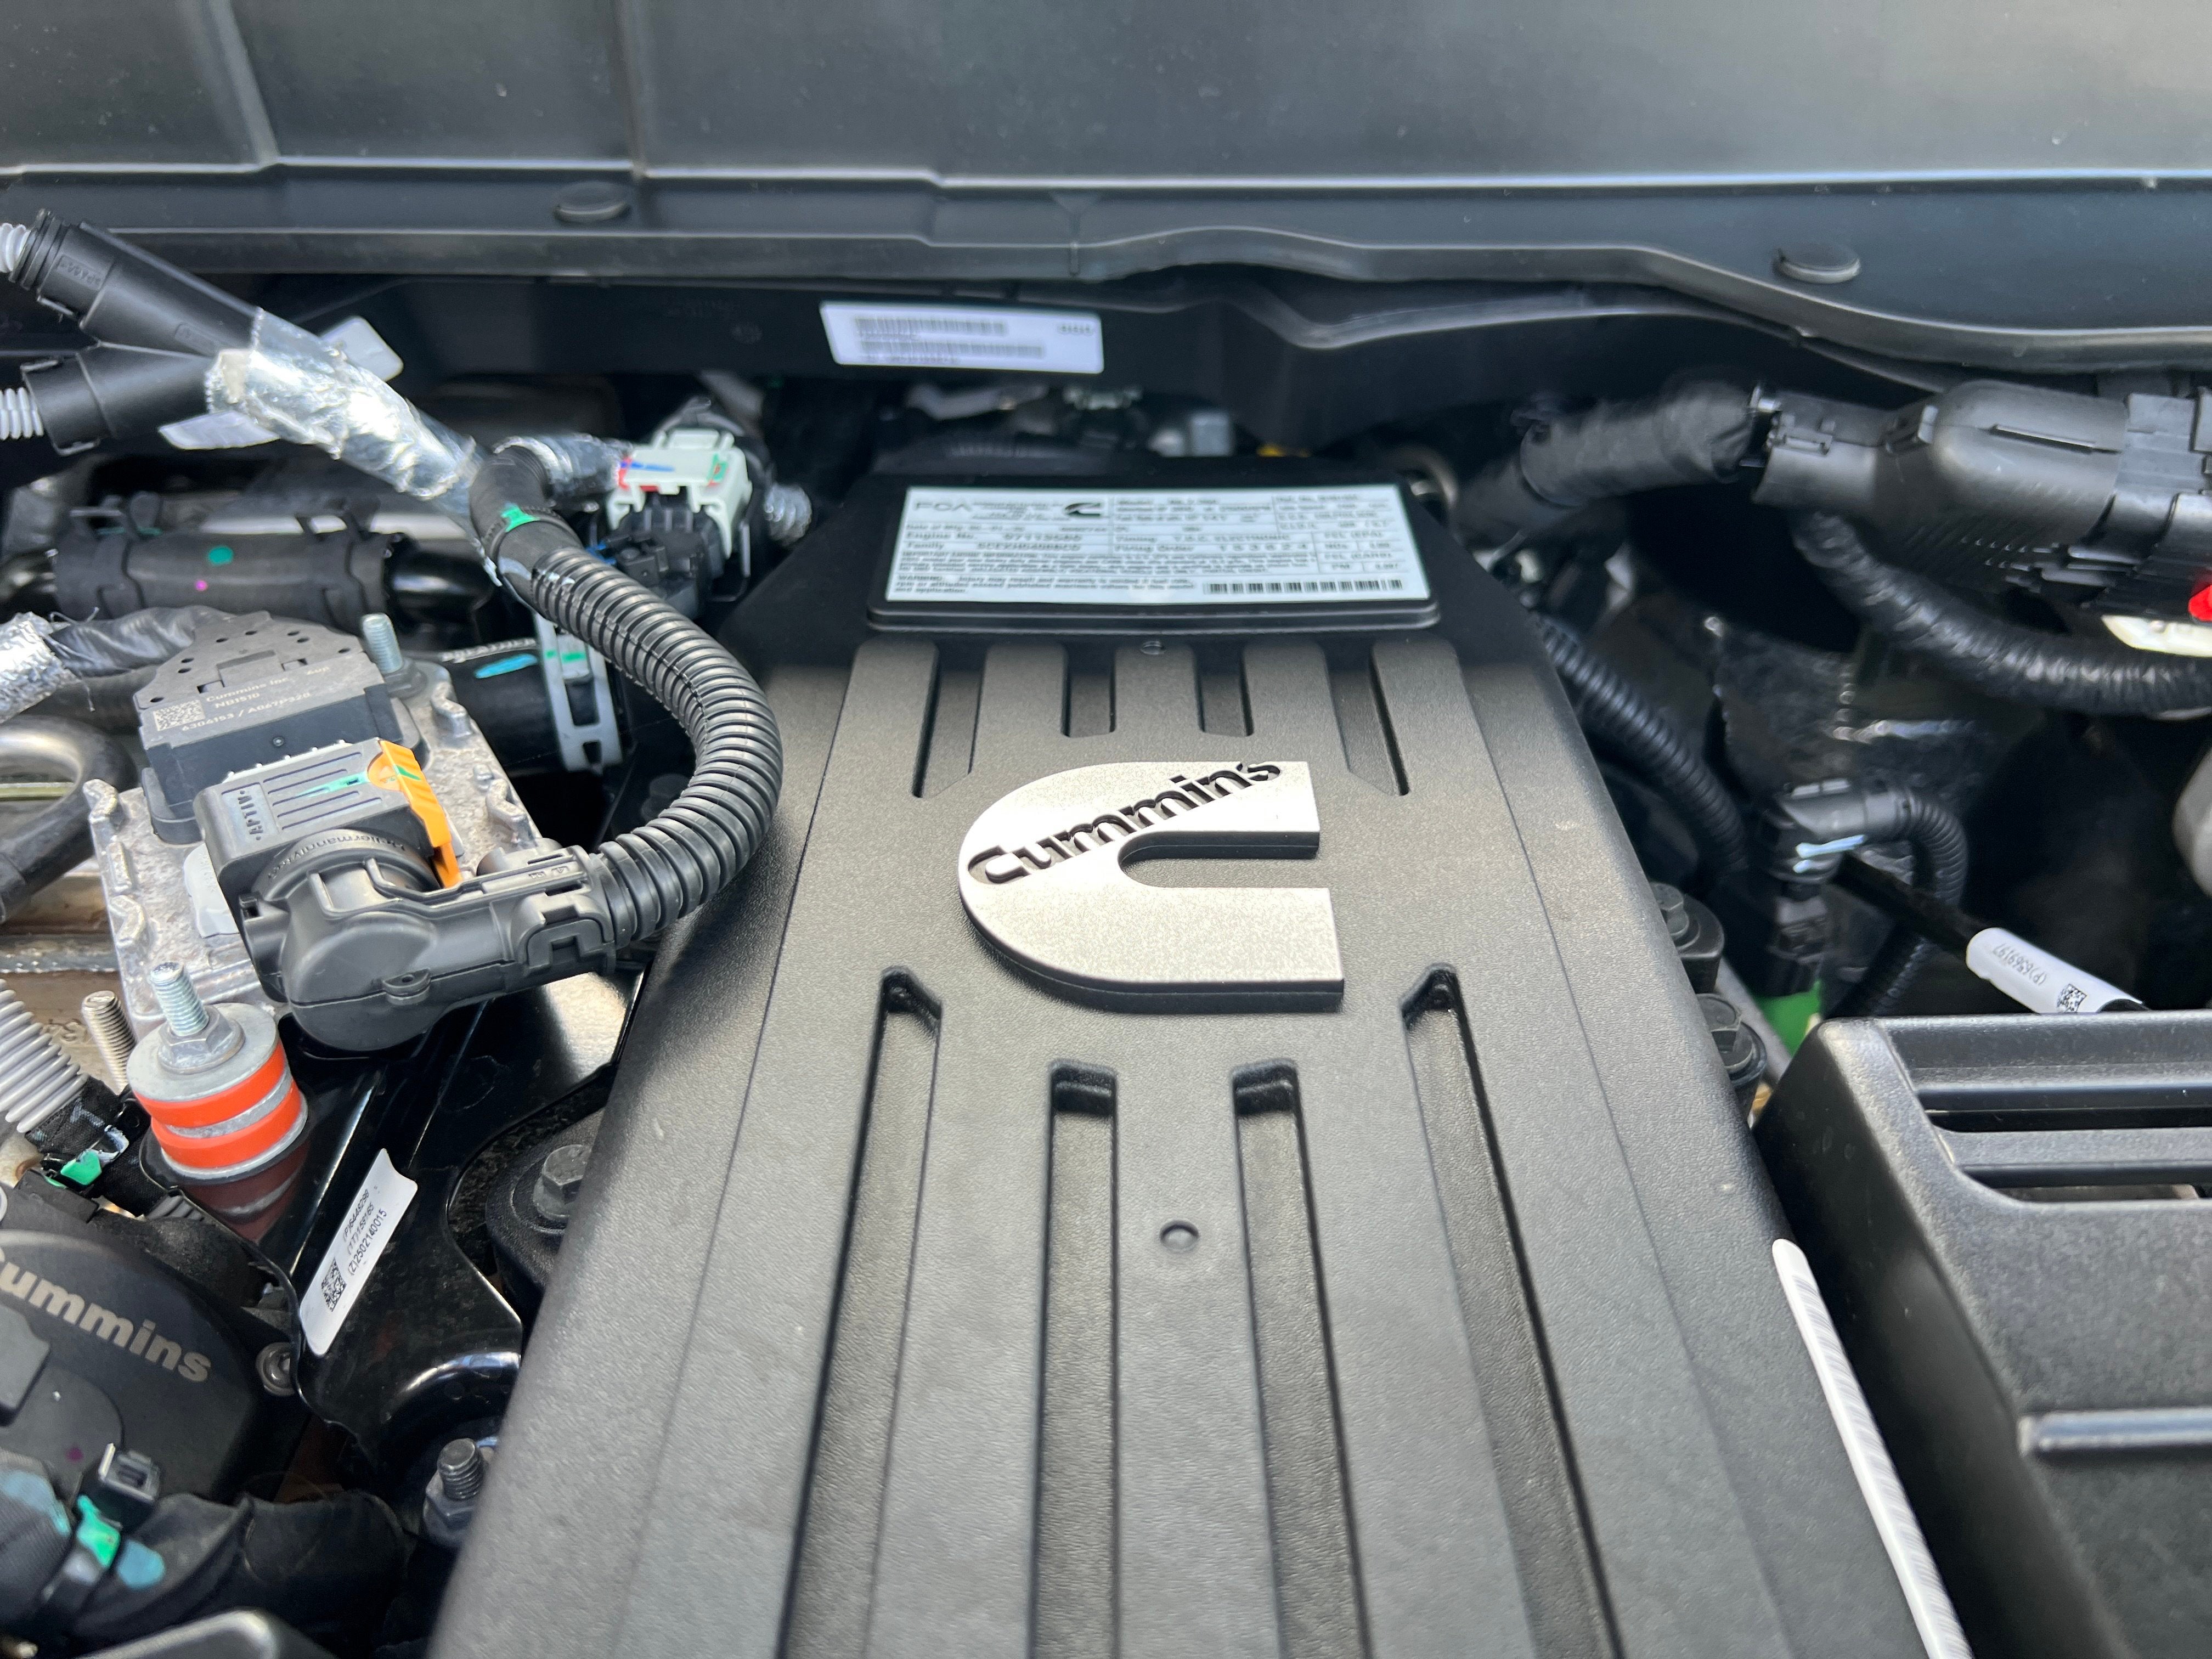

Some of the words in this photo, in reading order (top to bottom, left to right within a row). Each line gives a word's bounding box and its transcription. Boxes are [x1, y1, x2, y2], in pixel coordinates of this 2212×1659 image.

[915, 502, 972, 512] FCA
[907, 532, 952, 540] Engine
[1116, 535, 1157, 543] Timing
[906, 542, 945, 551] Family
[1115, 544, 1153, 552] Firing
[206, 682, 267, 703] Cummins
[238, 795, 263, 834] APTIV
[967, 762, 1281, 885] Cummins
[348, 1207, 387, 1276] (Z)2502140015
[0, 1248, 211, 1382] ummins
